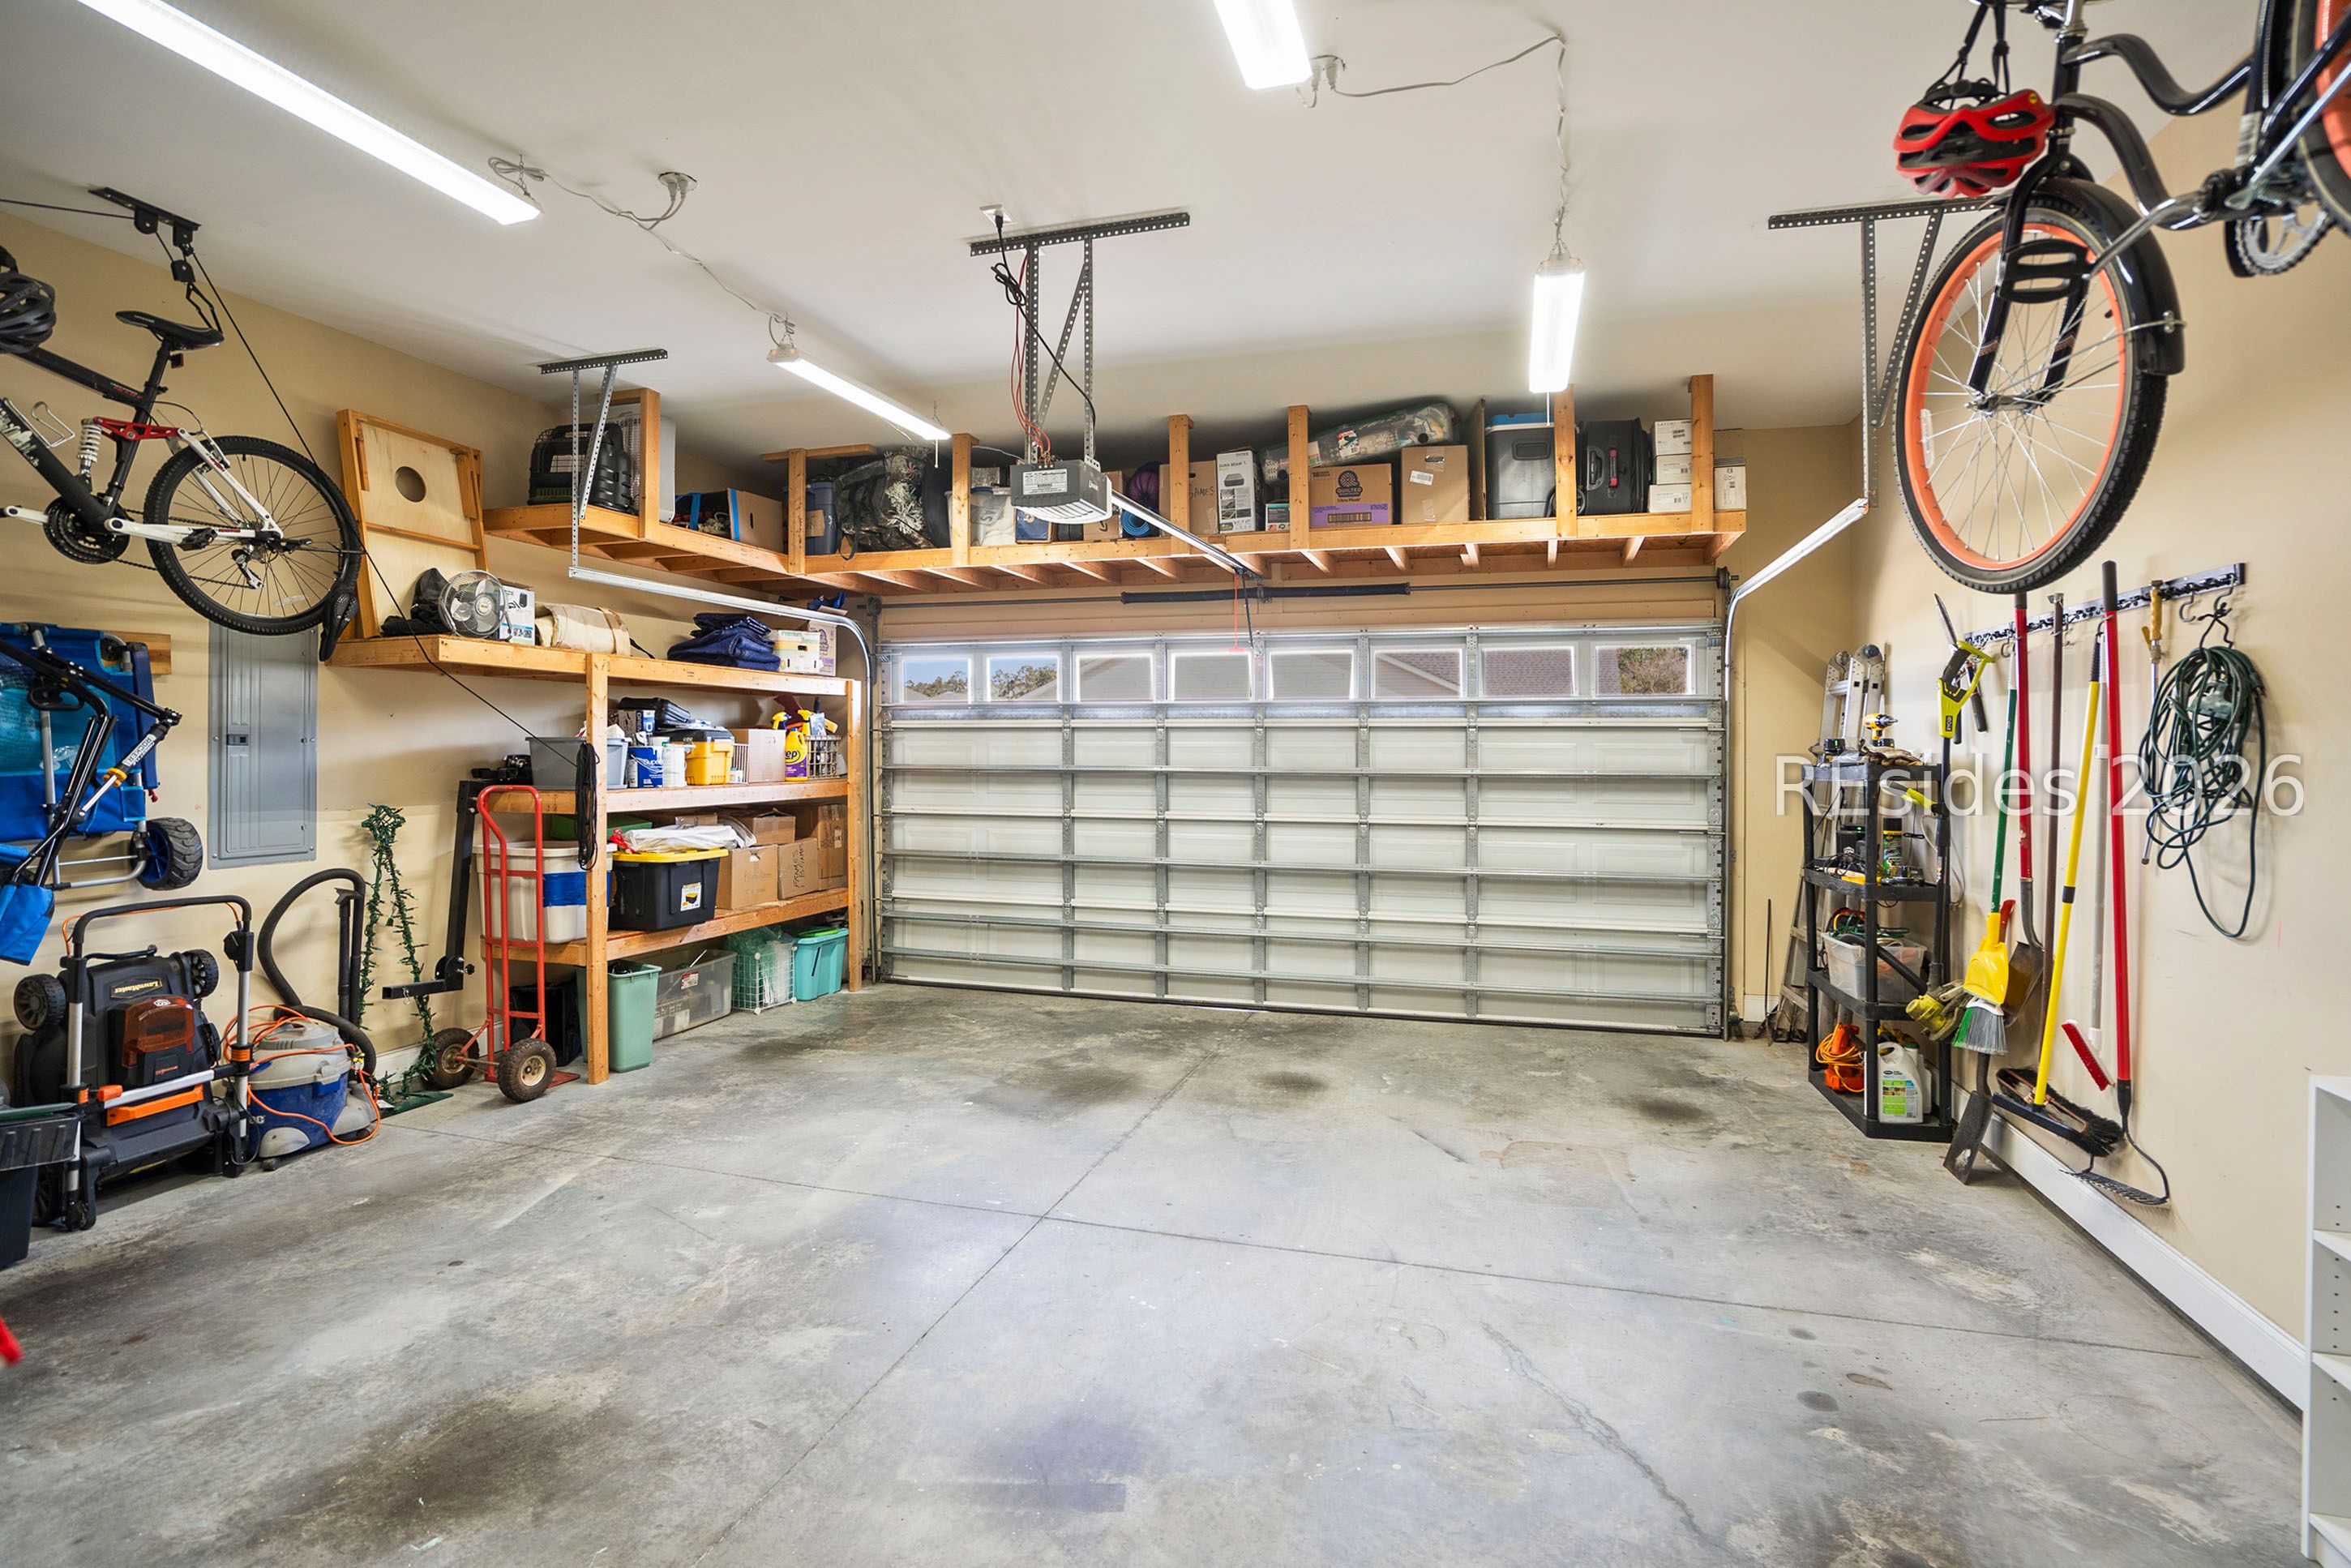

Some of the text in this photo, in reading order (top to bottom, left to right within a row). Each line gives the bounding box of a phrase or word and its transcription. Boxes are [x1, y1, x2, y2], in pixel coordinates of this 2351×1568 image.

[128, 737, 152, 762] ROCKER
[785, 750, 797, 760] ep
[113, 980, 159, 994] LawnMaster
